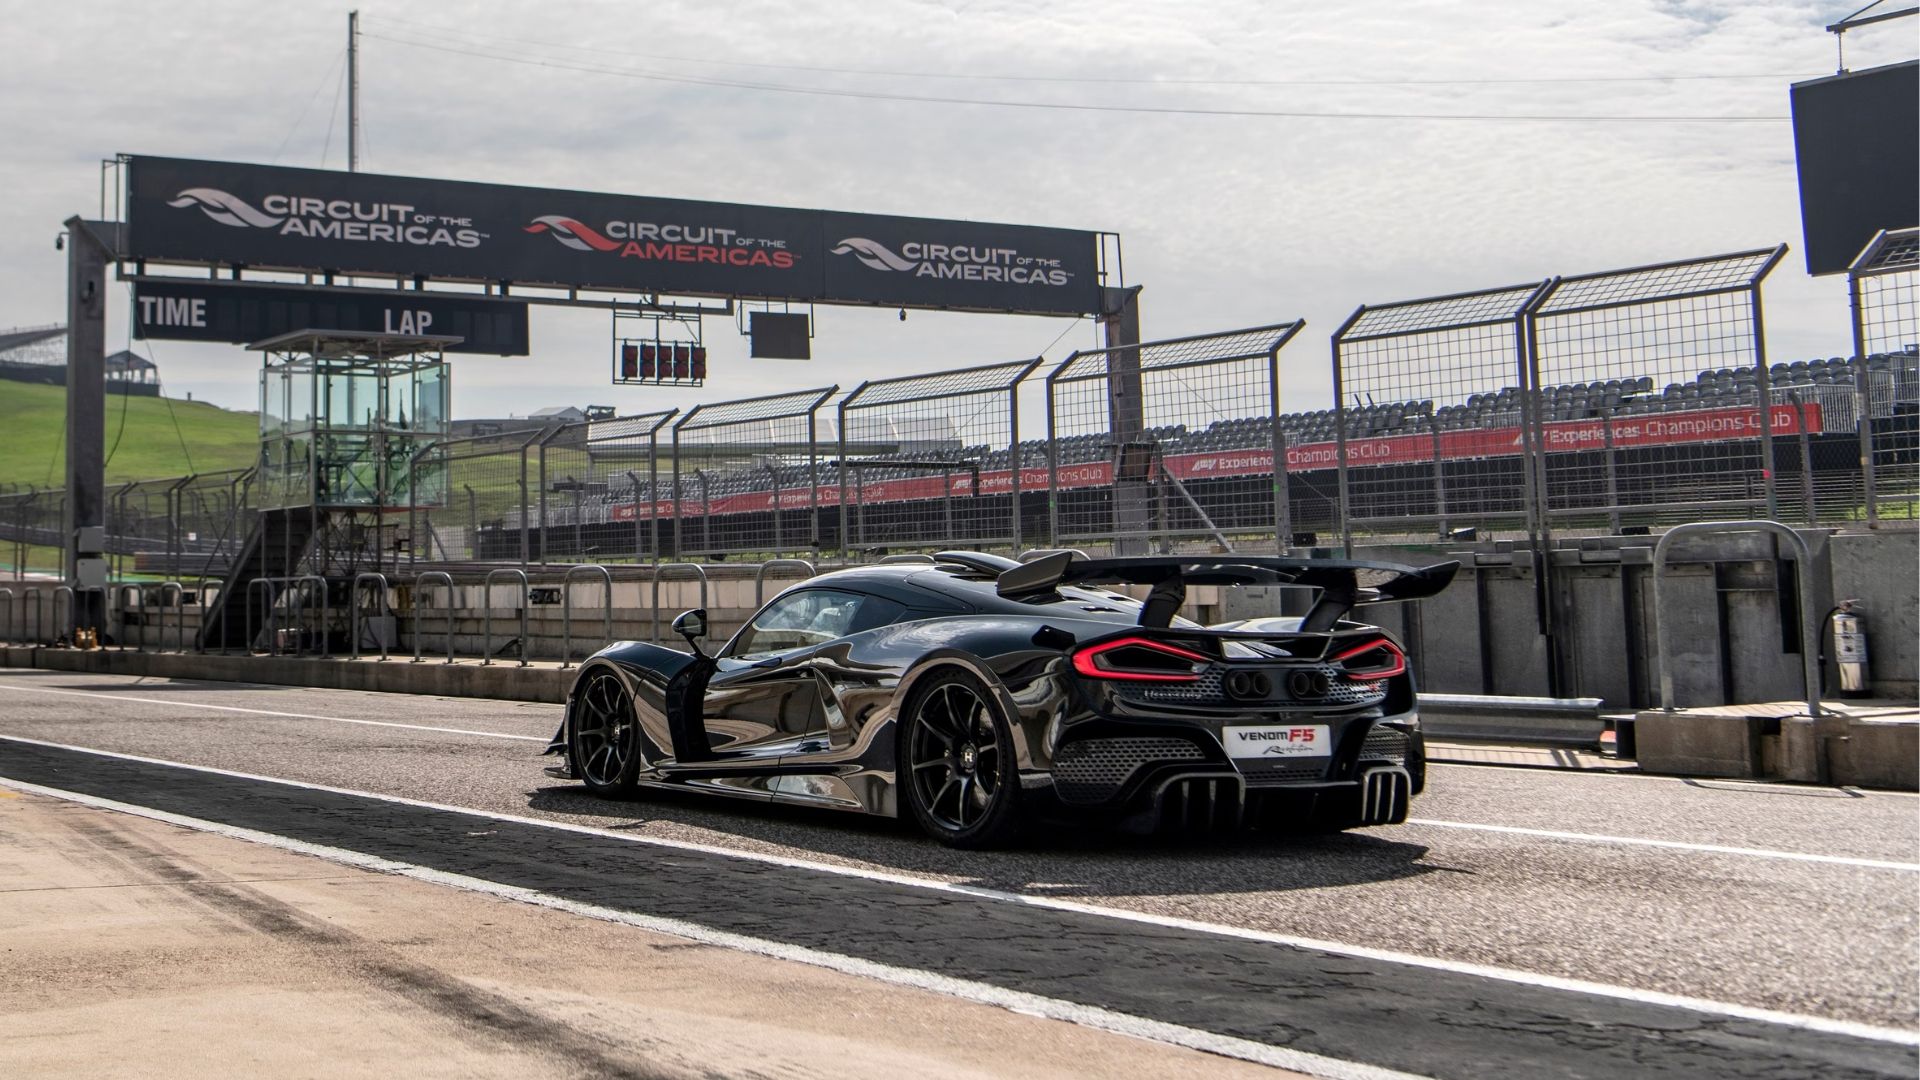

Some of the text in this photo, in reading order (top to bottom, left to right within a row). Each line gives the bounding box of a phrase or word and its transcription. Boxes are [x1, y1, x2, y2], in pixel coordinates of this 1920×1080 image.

[263, 195, 472, 227] CIRCUIT OF THE
[606, 221, 786, 249] CIRCUIT OF THE
[902, 242, 1061, 268] CIRCUIT OF THE
[139, 296, 206, 327] TIME
[384, 308, 433, 335] LAP
[1646, 416, 1745, 436] Champions
[1749, 411, 1791, 429] Cub
[1219, 456, 1275, 470] Experienc
[1360, 444, 1390, 458] Club
[1025, 470, 1078, 484] Chamions
[1080, 466, 1102, 480] Club
[1238, 728, 1316, 742] VENOM F5
